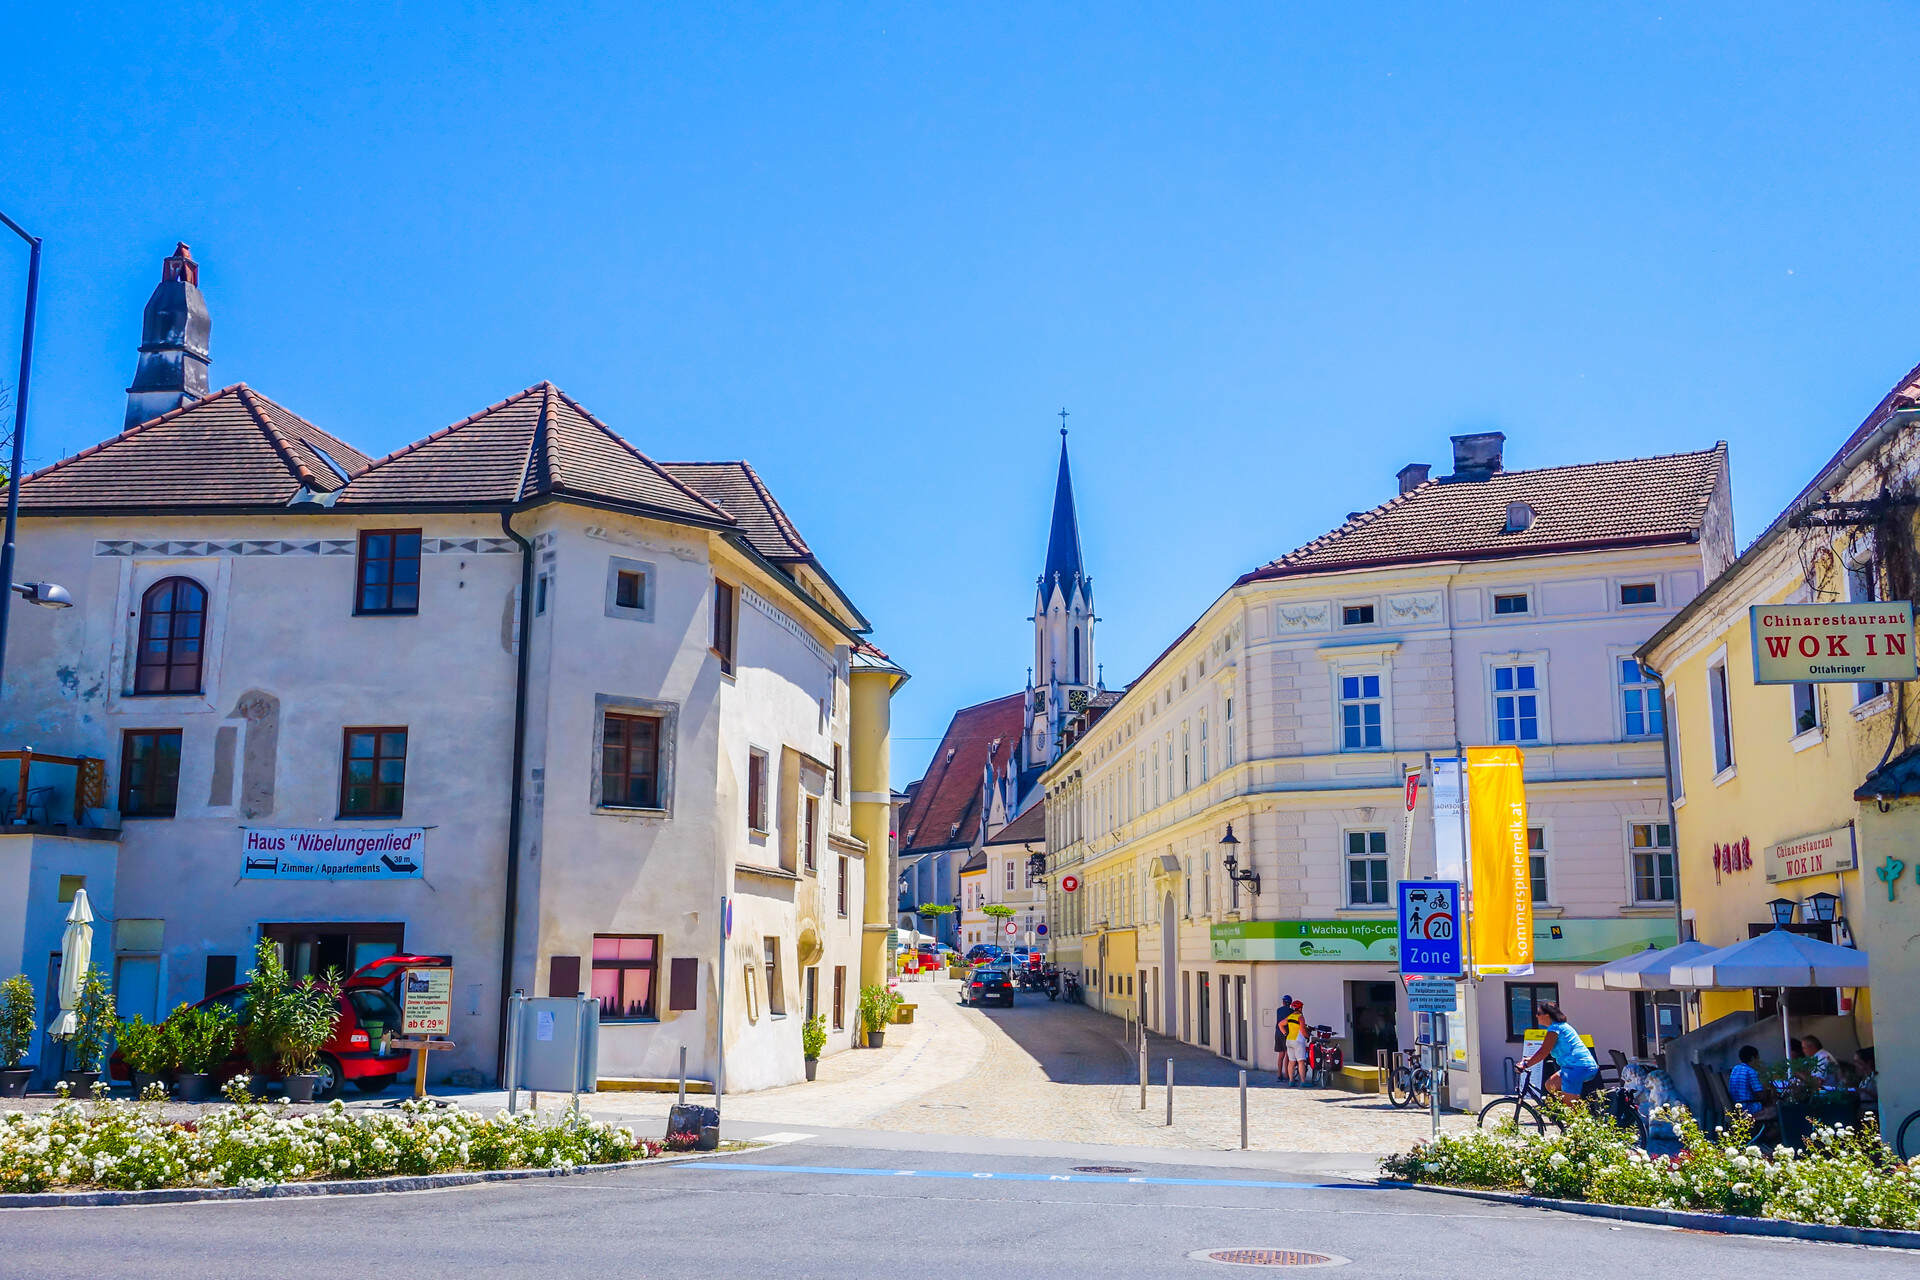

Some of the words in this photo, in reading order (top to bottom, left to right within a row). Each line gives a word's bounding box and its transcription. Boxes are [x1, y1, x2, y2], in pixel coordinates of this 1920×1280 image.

[1763, 612, 1906, 627] Chinarestaurant
[1765, 635, 1850, 658] WOK
[1865, 633, 1907, 656] IN
[247, 832, 286, 851] Haus
[1776, 835, 1833, 859] Chinarestaurant
[281, 863, 313, 873] Zimmer
[321, 863, 381, 874] Appartements
[1786, 858, 1808, 877] WOK
[1811, 854, 1823, 872] IN
[1509, 801, 1529, 958] sommerspielemelk.at
[1311, 925, 1349, 935] Wachau
[1351, 924, 1398, 936] Info-Cent
[1433, 921, 1451, 938] 20
[1410, 948, 1451, 964] Zone
[408, 1019, 418, 1028] ab
[420, 1020, 425, 1028] €
[427, 1019, 437, 1028] 29
